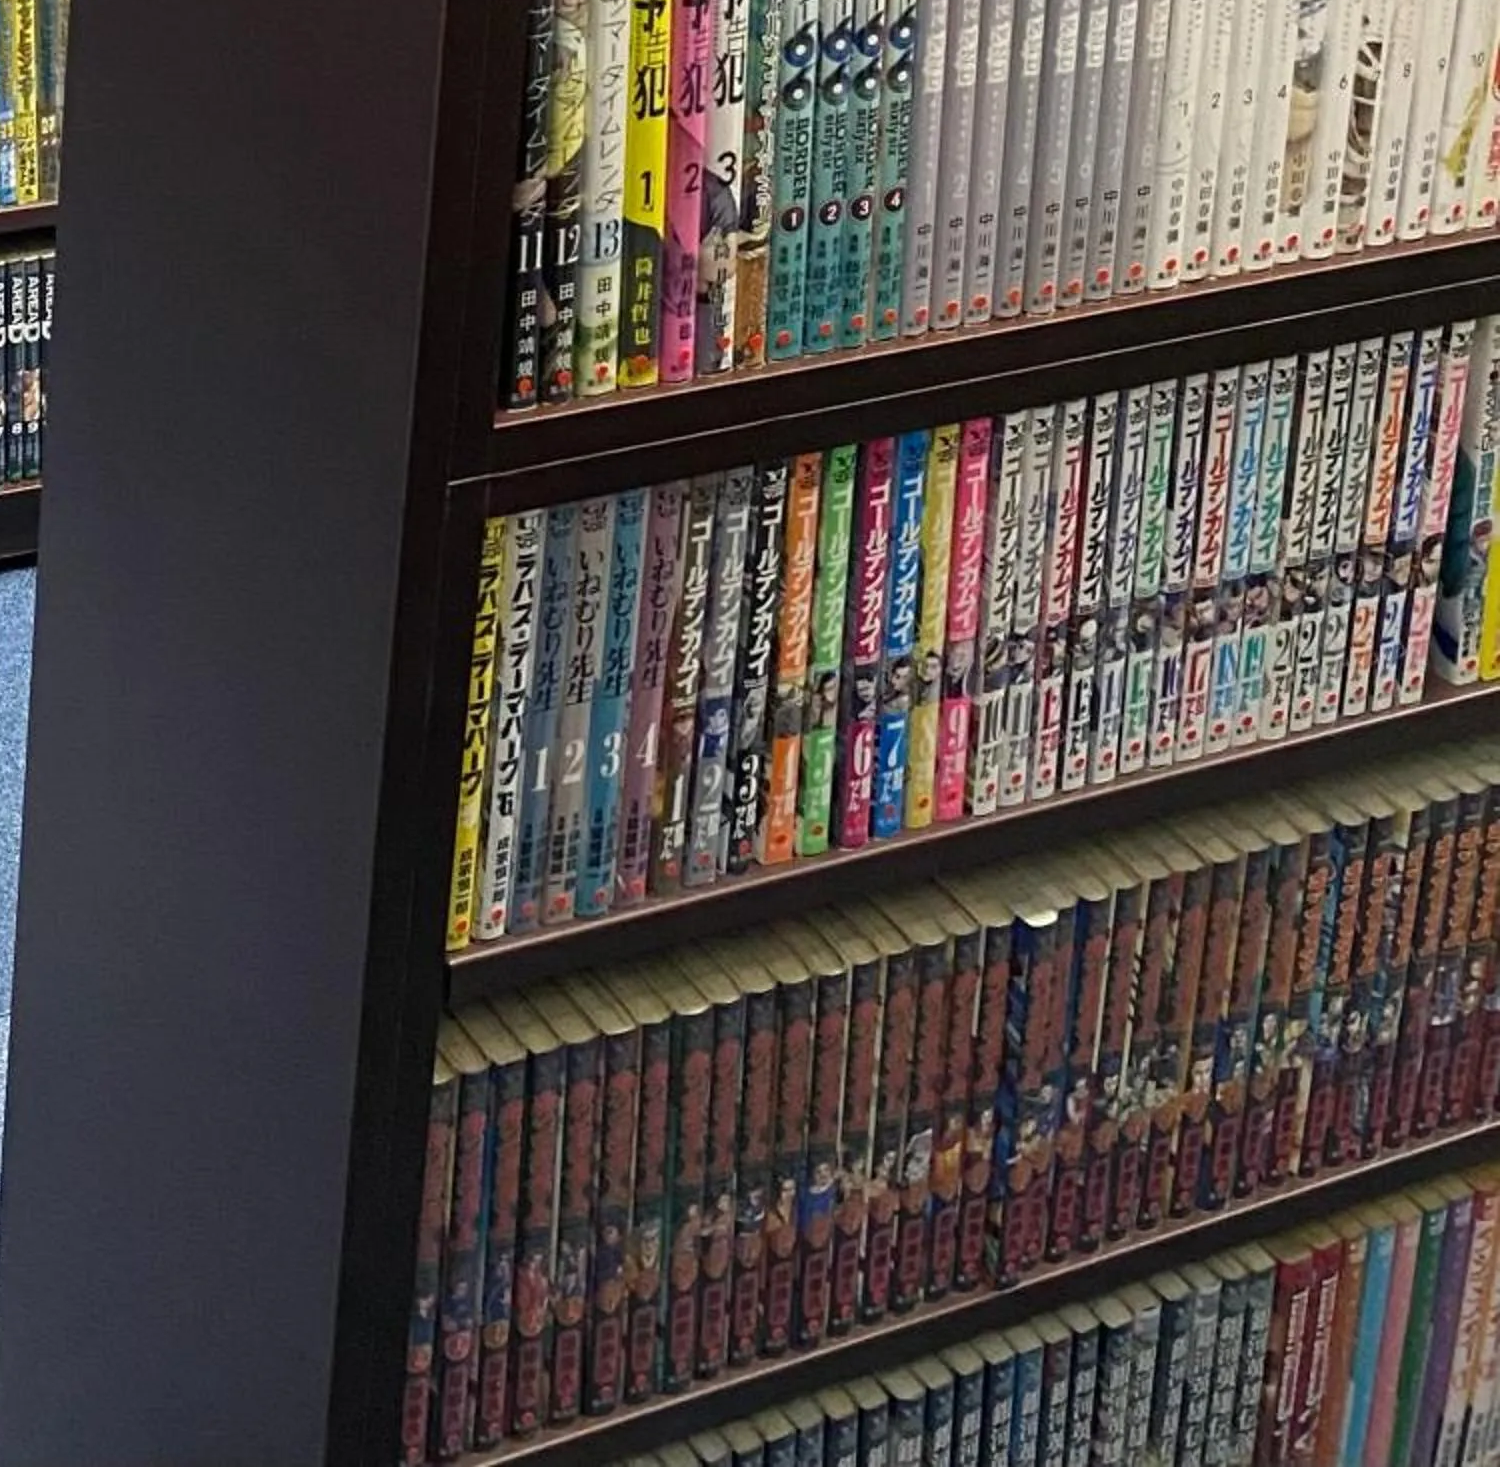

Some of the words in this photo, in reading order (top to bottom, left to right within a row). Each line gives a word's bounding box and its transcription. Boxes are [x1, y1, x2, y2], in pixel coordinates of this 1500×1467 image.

[640, 171, 654, 207] 1
[684, 162, 700, 193] 2
[719, 152, 737, 185] 3
[518, 235, 543, 272] 11
[556, 225, 580, 263] 12
[593, 221, 619, 258] 13
[855, 484, 889, 660] ゴールデンカムイ
[892, 475, 924, 653] ゴールデンカムイ
[747, 504, 785, 676] ゴールデンカムイ
[563, 739, 585, 784] 2
[600, 733, 621, 778] 3
[635, 723, 656, 768] 4
[532, 748, 548, 792] 1
